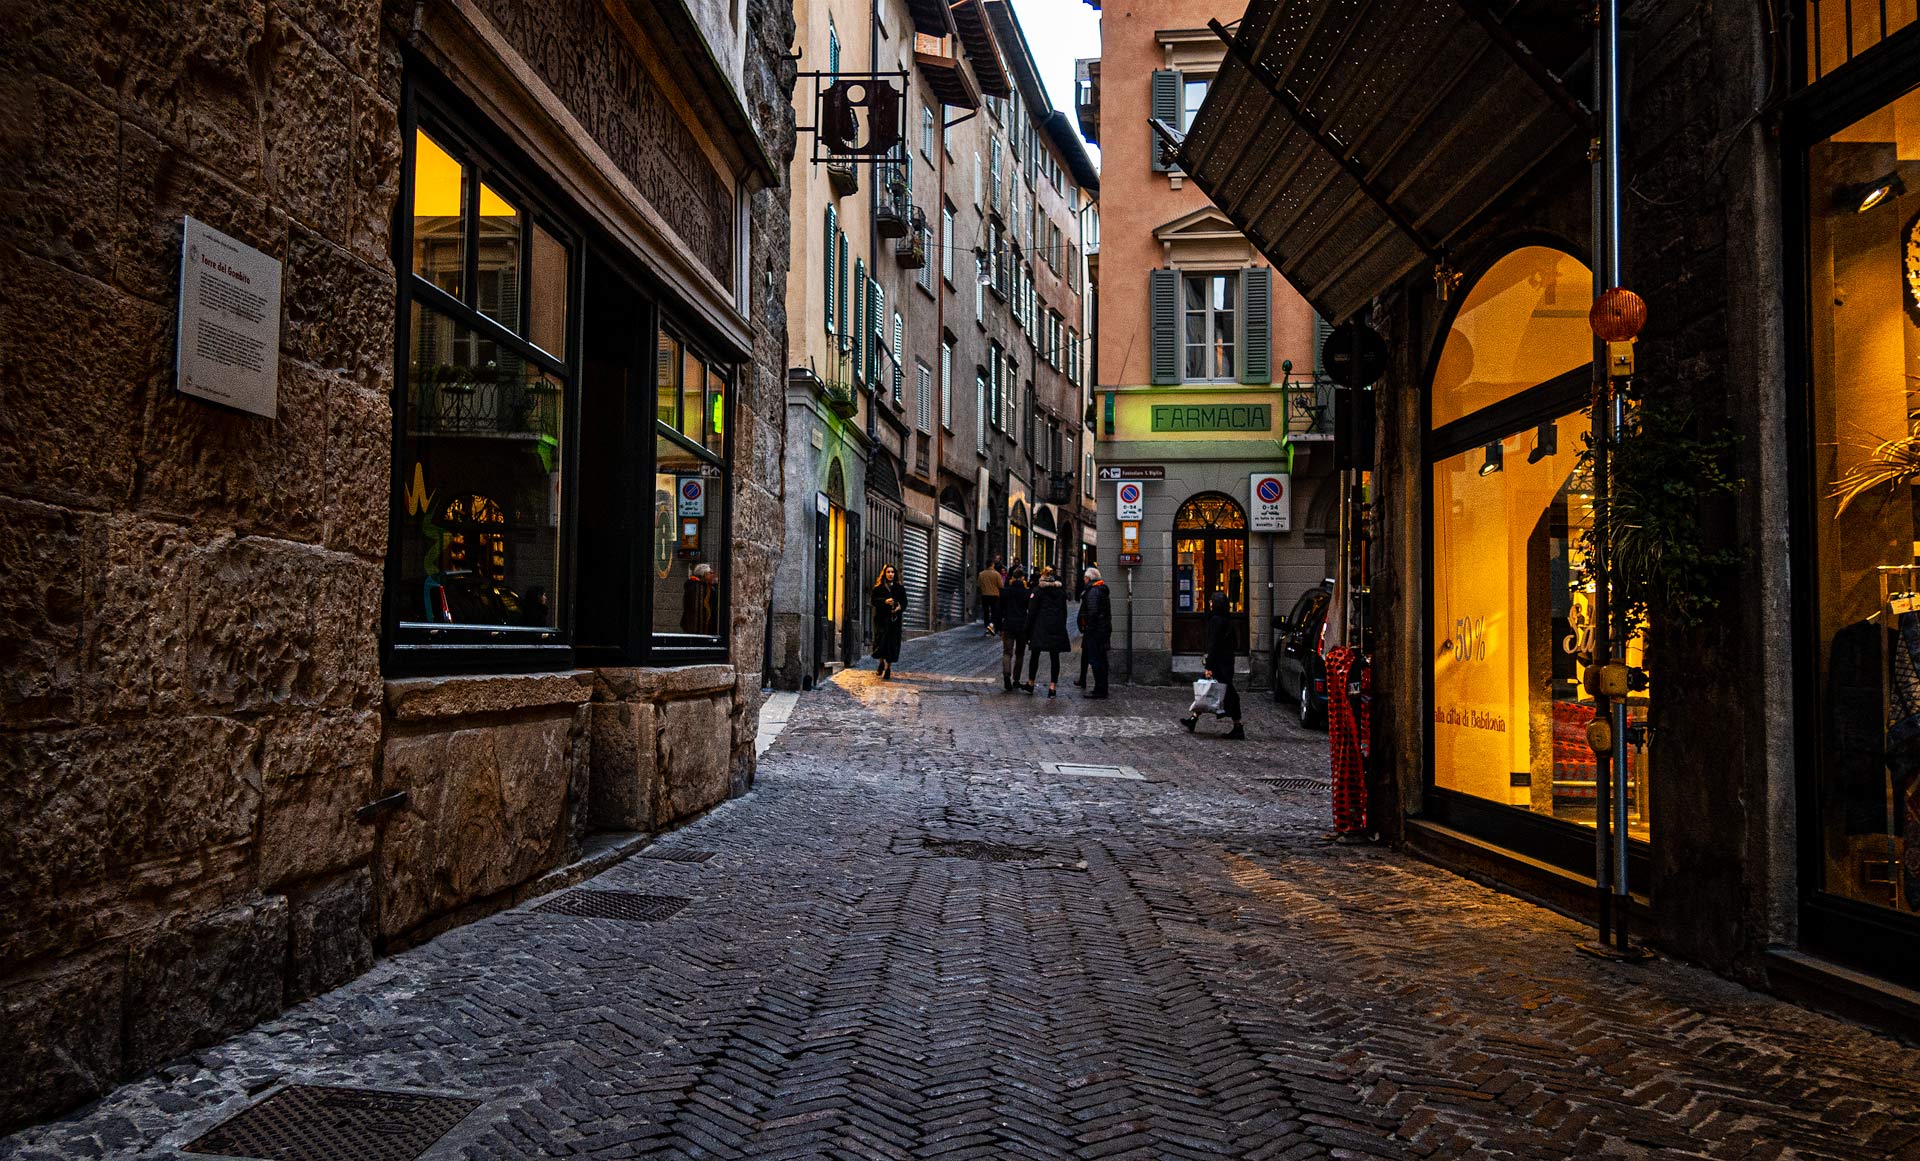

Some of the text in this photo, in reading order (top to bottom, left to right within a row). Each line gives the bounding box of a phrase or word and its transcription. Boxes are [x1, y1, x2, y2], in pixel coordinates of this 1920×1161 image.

[201, 254, 251, 285] Torre del Gombito
[1155, 407, 1265, 428] FARMACIA
[1470, 709, 1506, 733] Babilonia
